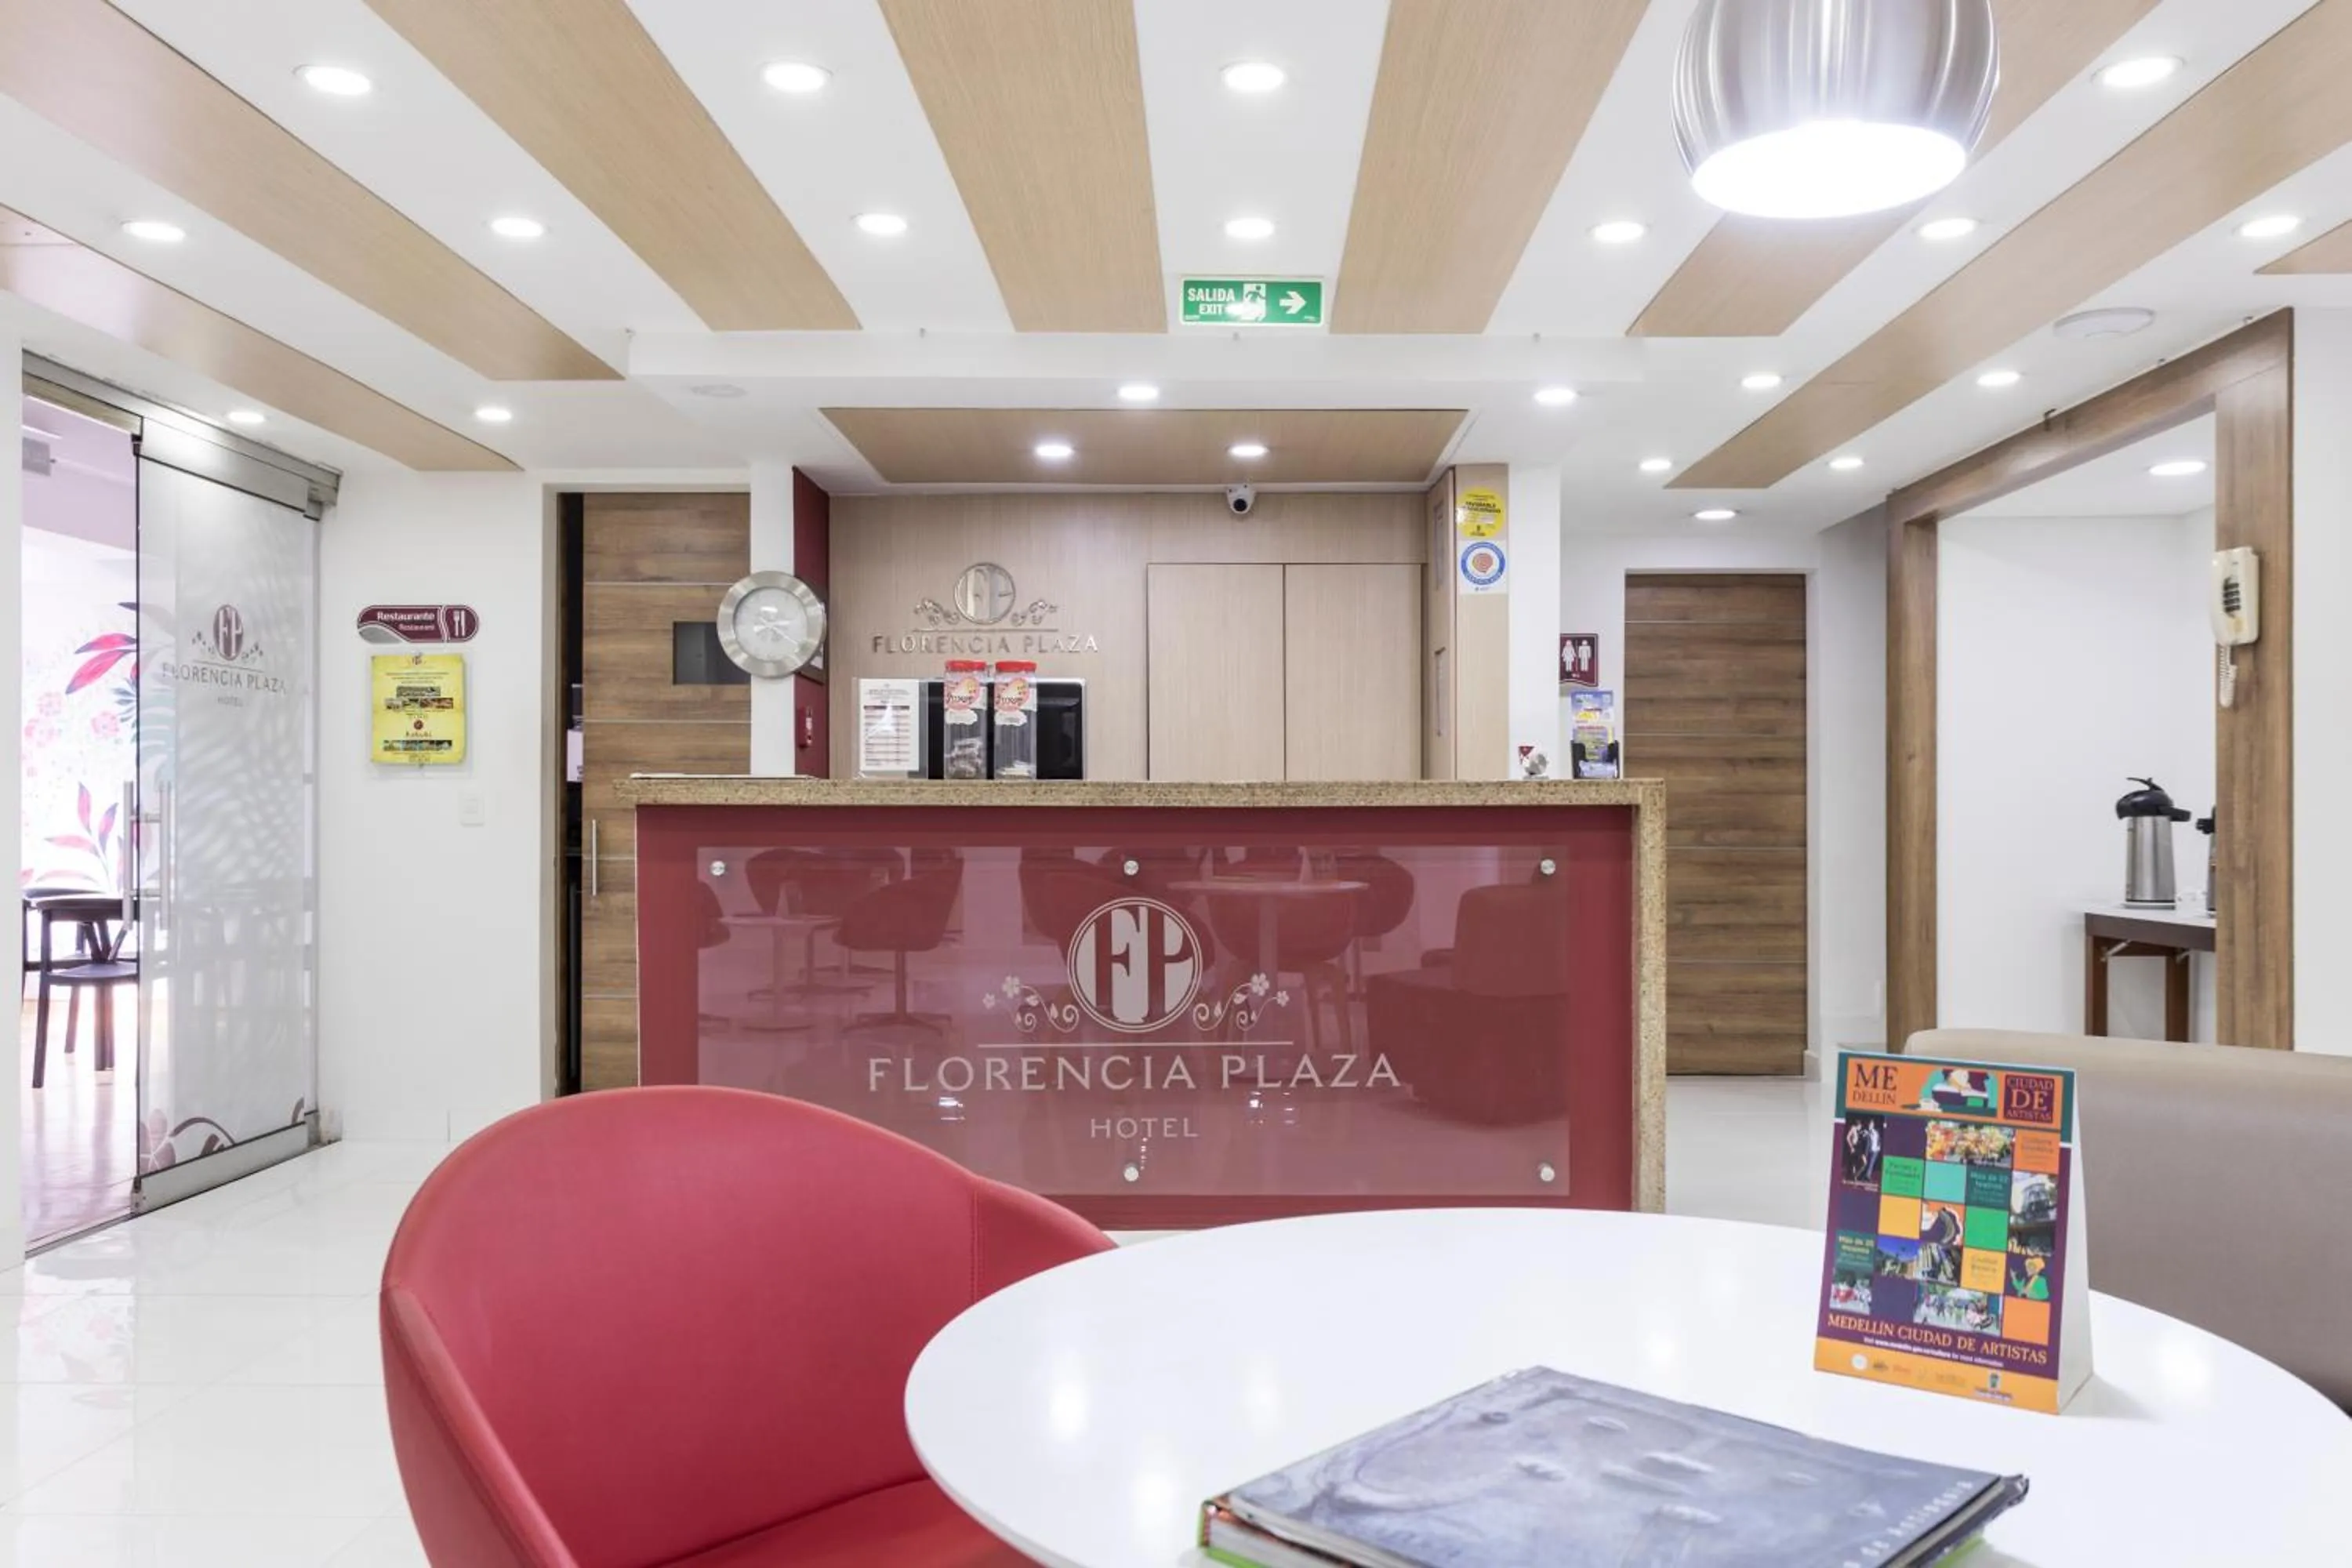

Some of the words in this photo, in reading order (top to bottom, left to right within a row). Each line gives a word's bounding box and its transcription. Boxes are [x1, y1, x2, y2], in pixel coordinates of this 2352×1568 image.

[1188, 288, 1236, 302] SALIDA
[1199, 303, 1224, 314] EXIT
[377, 611, 435, 621] Restaurante
[873, 635, 1010, 654] FLORENCIA
[1023, 635, 1098, 654] PLAZA
[162, 662, 242, 688] FLORENCIA
[247, 673, 286, 695] PLAZA
[868, 1054, 1197, 1092] FLORENCIA
[1221, 1052, 1402, 1088] PLAZA
[1854, 1063, 1898, 1091] ME
[2007, 1077, 2053, 1091] CIUDAD
[2011, 1088, 2048, 1111] DE
[1090, 1117, 1200, 1139] HOTEL
[1897, 1324, 1952, 1347] CIUDAD
[1957, 1336, 1976, 1352] DE
[1980, 1341, 2048, 1365] ARTISTAS
